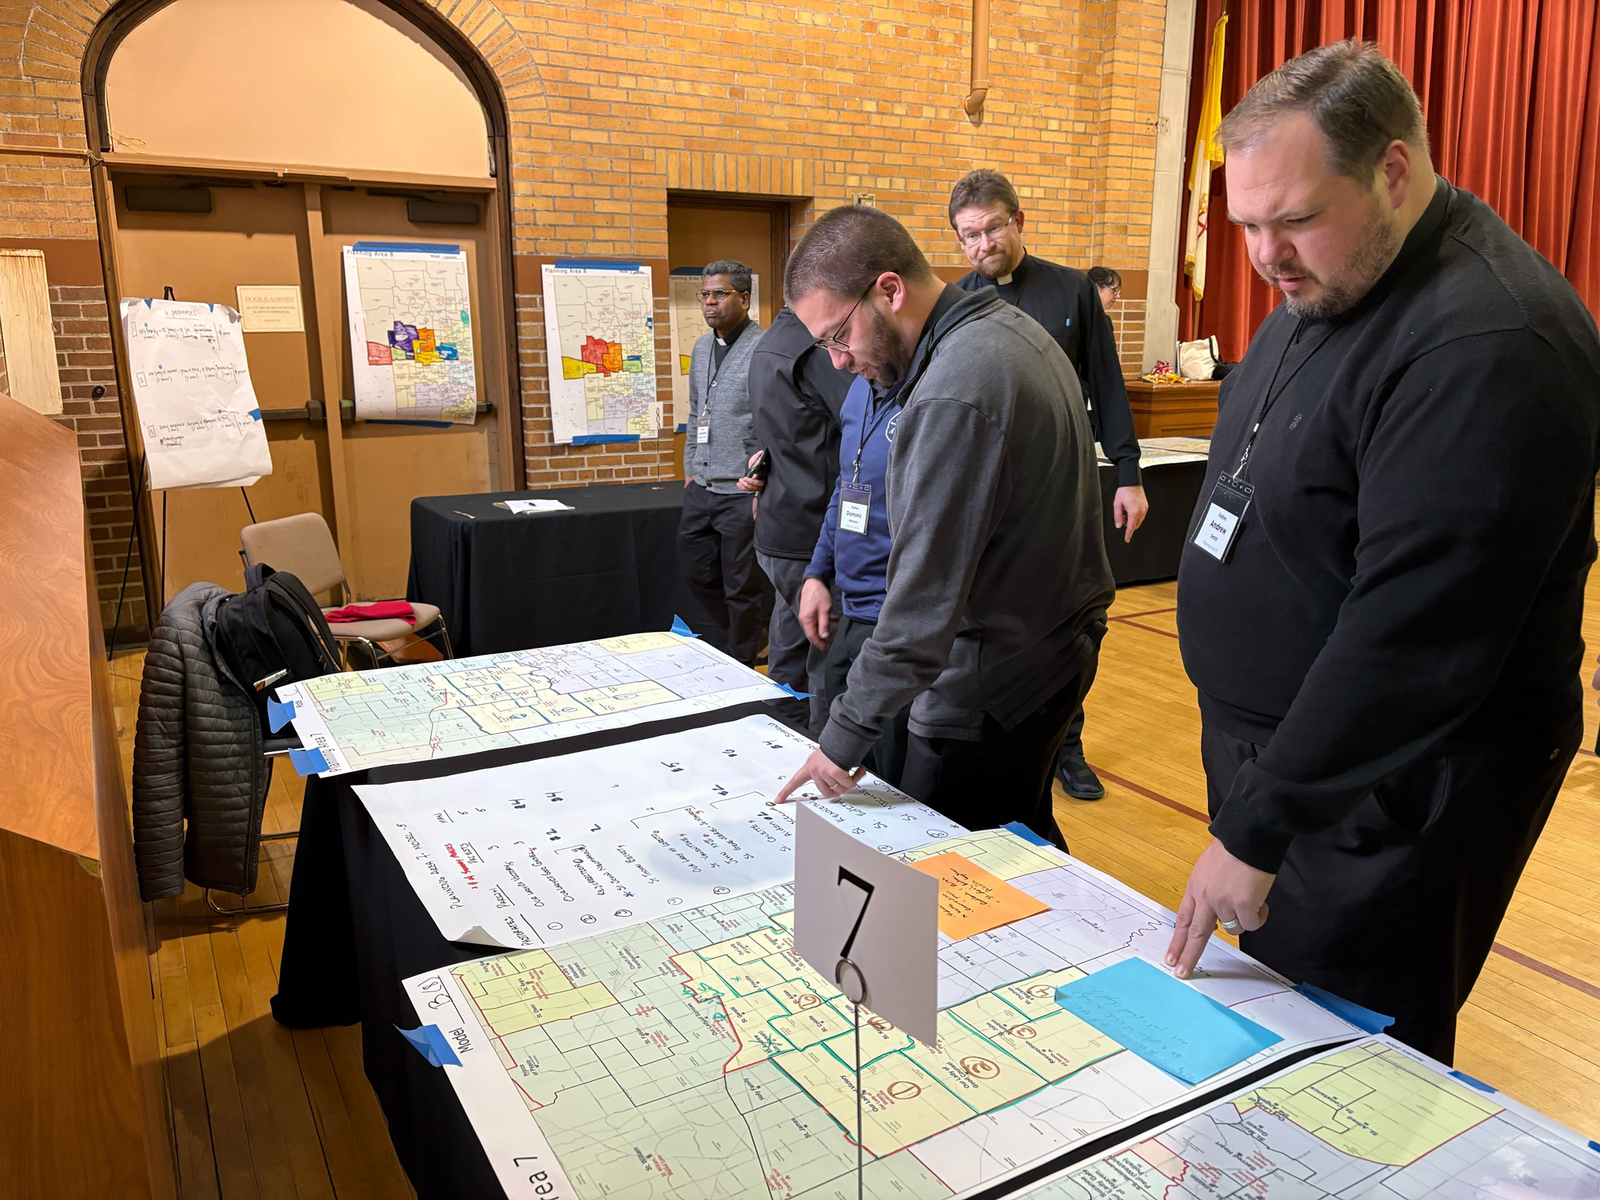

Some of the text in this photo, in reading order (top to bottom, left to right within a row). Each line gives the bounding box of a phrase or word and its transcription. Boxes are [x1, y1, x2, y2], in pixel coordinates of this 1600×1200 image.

[846, 510, 862, 518] Dominic
[1210, 520, 1226, 535] Andrew
[315, 736, 329, 748] Area
[322, 748, 342, 773] Planning
[874, 782, 915, 803] GERALD
[750, 824, 776, 842] COLETTE
[770, 821, 792, 836] Aidan
[675, 853, 690, 862] LADY
[720, 852, 738, 864] JOHN
[405, 832, 463, 909] PLANNING AREA MODEL
[688, 863, 702, 872] OUR
[575, 863, 605, 895] RESURRECTION
[490, 888, 509, 908] PARISH
[531, 896, 544, 907] OUR
[838, 866, 874, 960] 7
[736, 941, 747, 950] Loretto
[763, 933, 777, 944] Valentine
[777, 952, 796, 966] Genevieve
[954, 951, 970, 962] Richard
[624, 960, 635, 969] Church
[662, 962, 677, 977] Providence
[518, 978, 526, 986] Regis
[418, 977, 454, 1010] B (8)
[783, 990, 794, 999] Aidan
[1008, 987, 1024, 1000] Thomas
[530, 1004, 539, 1013] Owen
[685, 1003, 700, 1016] Sorrows
[730, 1006, 742, 1018] Gerald
[703, 1020, 712, 1029] Lady
[809, 1015, 822, 1027] Colette
[986, 1022, 998, 1031] John
[991, 1019, 1012, 1034] Neumann
[635, 1027, 646, 1039] Fabian
[449, 1028, 473, 1053] Model
[1026, 1041, 1055, 1064] Resurrection
[1056, 1053, 1070, 1063] Canton
[517, 1064, 530, 1076] Prince
[526, 1060, 536, 1071] Peace
[946, 1062, 978, 1088] Good Counsel
[949, 1071, 961, 1080] Lady
[743, 1078, 765, 1100] Holy Family
[840, 1075, 878, 1112] Our Lady Victory
[1308, 1086, 1343, 1107] Constance
[1254, 1100, 1272, 1112] Lady
[791, 1117, 804, 1131] James
[1236, 1121, 1255, 1135] Maria
[1246, 1121, 1268, 1136] Goretti
[1347, 1116, 1368, 1129] Alfred
[634, 1147, 652, 1171] St. William
[1215, 1142, 1256, 1171] Sacred Heart
[1123, 1158, 1144, 1175] Polish)
[513, 1156, 560, 1200] rea 7
[1083, 1169, 1112, 1193] Lady Gate
[1095, 1170, 1118, 1188] Heaven
[1135, 1177, 1151, 1188] Paul
[1191, 1174, 1214, 1192] Anselm
[1081, 1177, 1106, 1197] Suzanne
